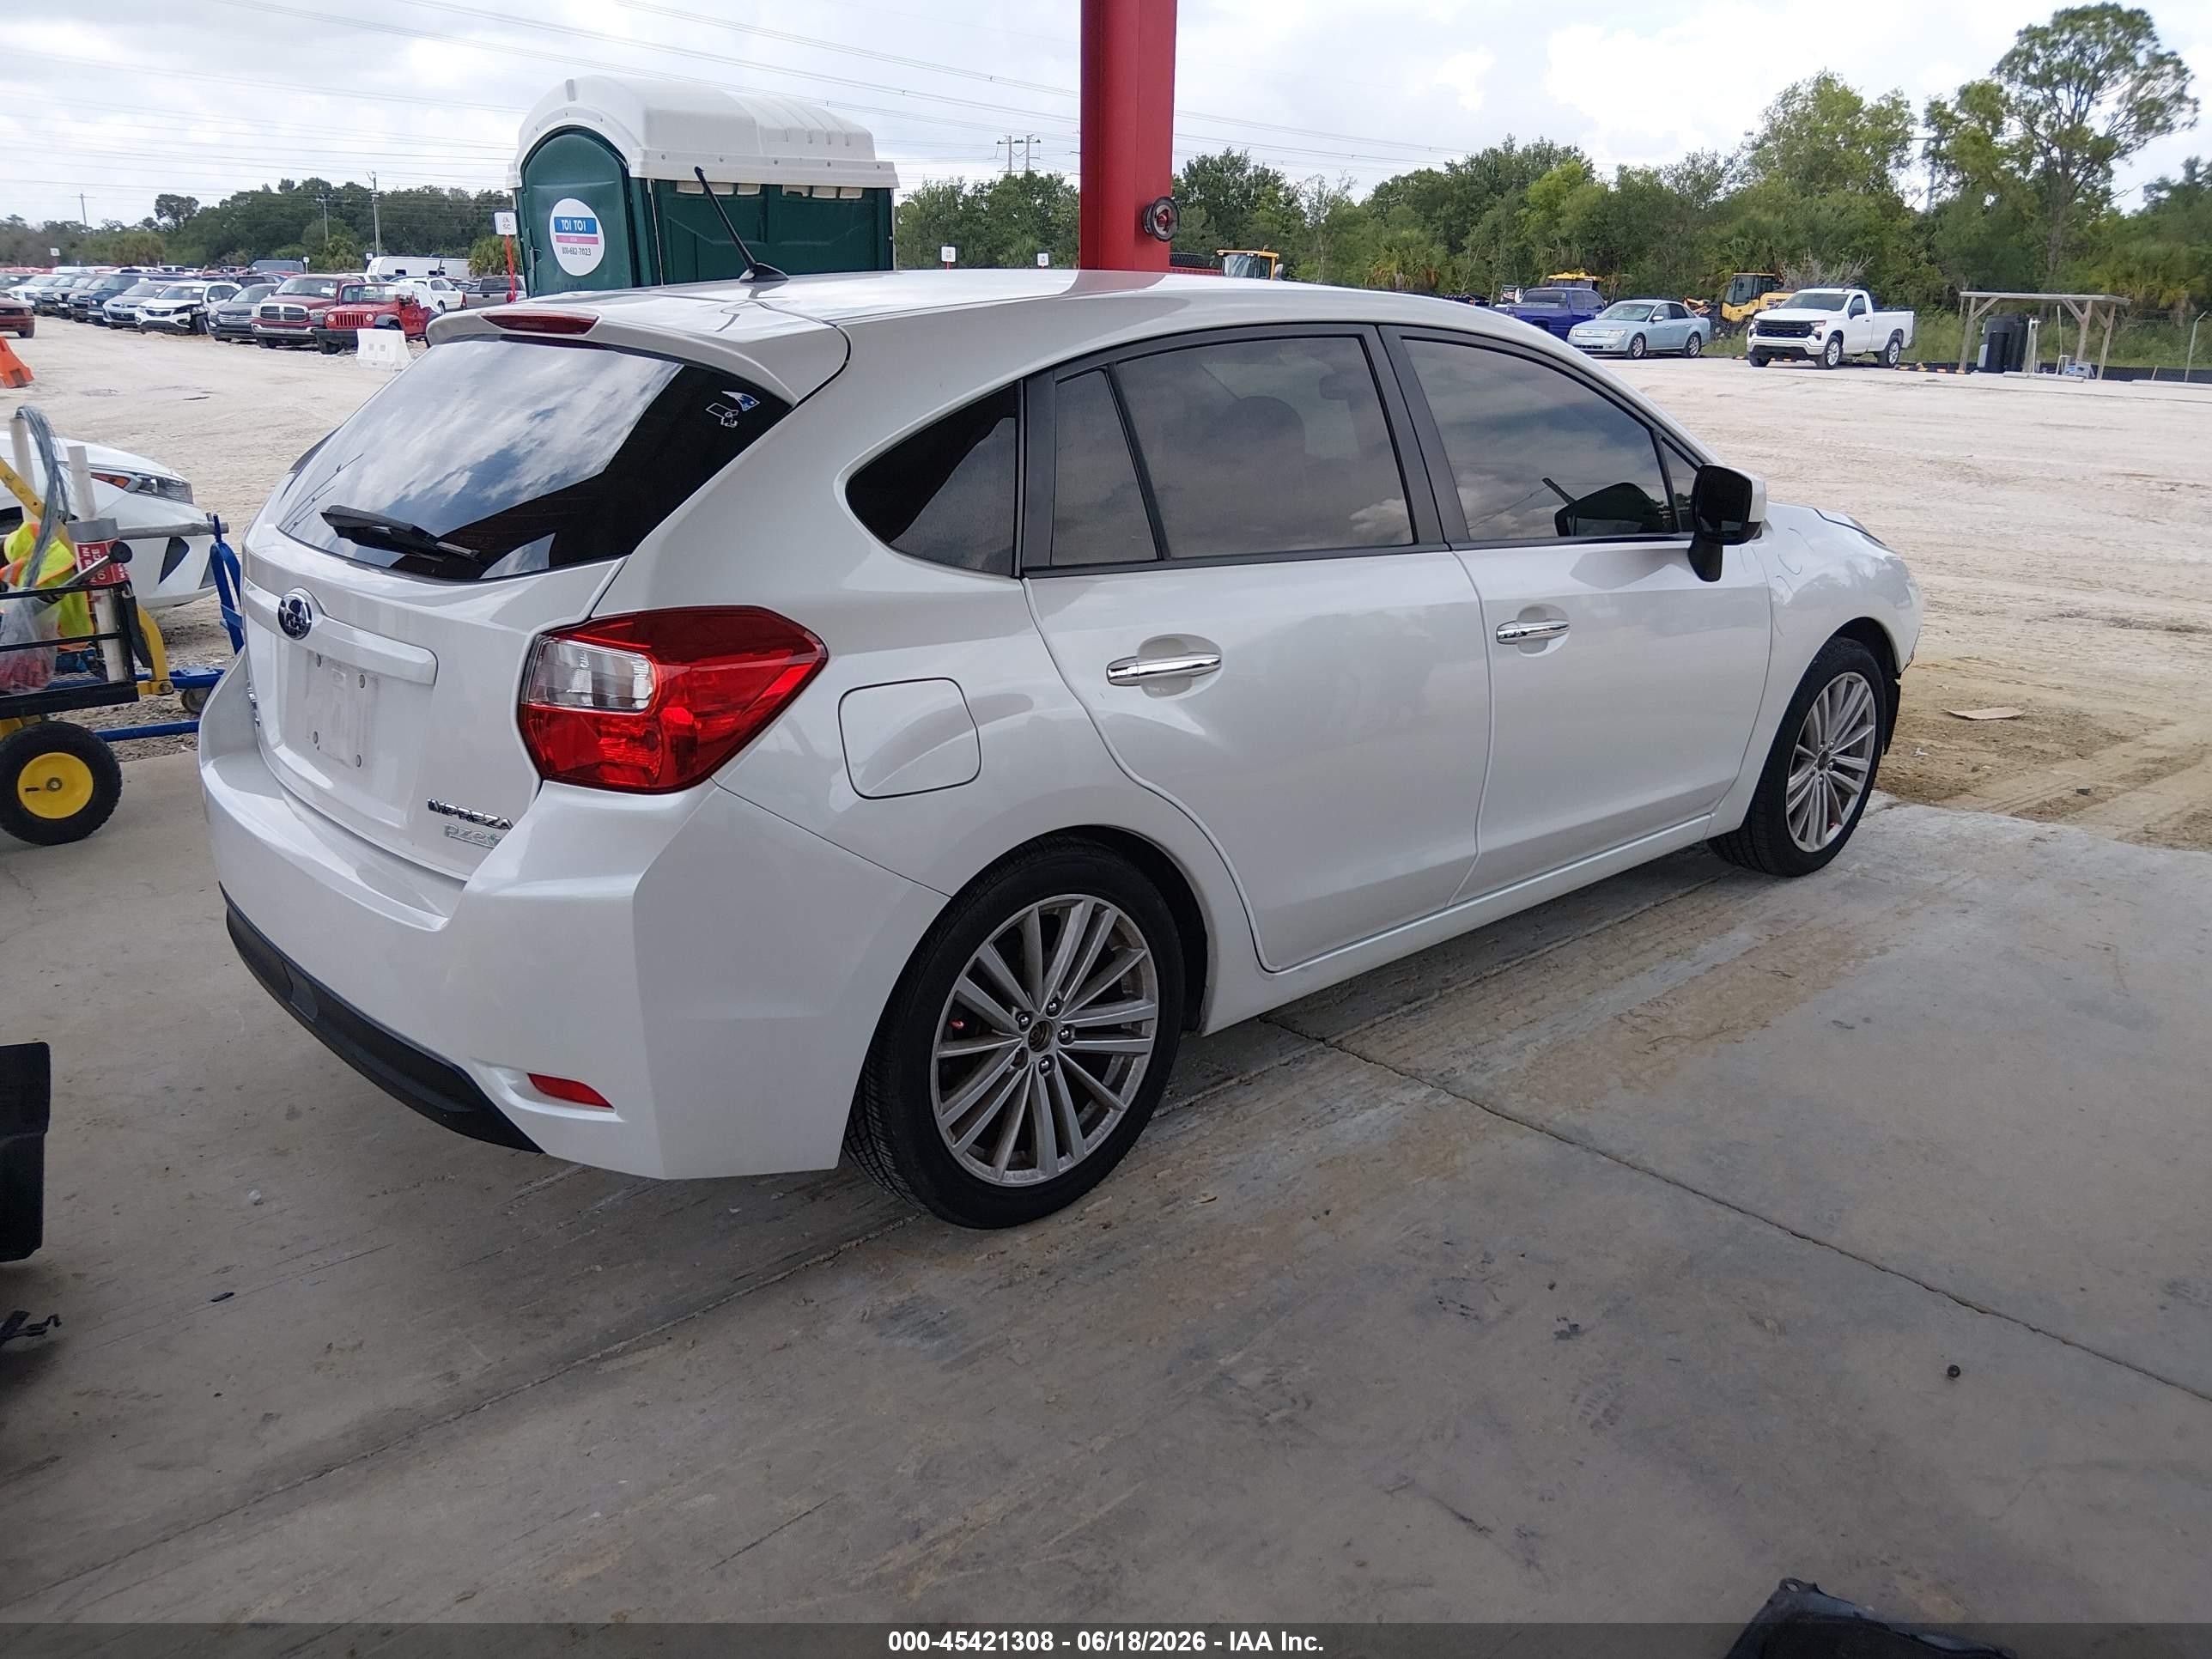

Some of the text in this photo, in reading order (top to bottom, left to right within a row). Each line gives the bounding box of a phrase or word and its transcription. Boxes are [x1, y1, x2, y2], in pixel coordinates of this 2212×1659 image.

[561, 219, 586, 231] TOI TOI
[427, 798, 514, 830] IMPREZA
